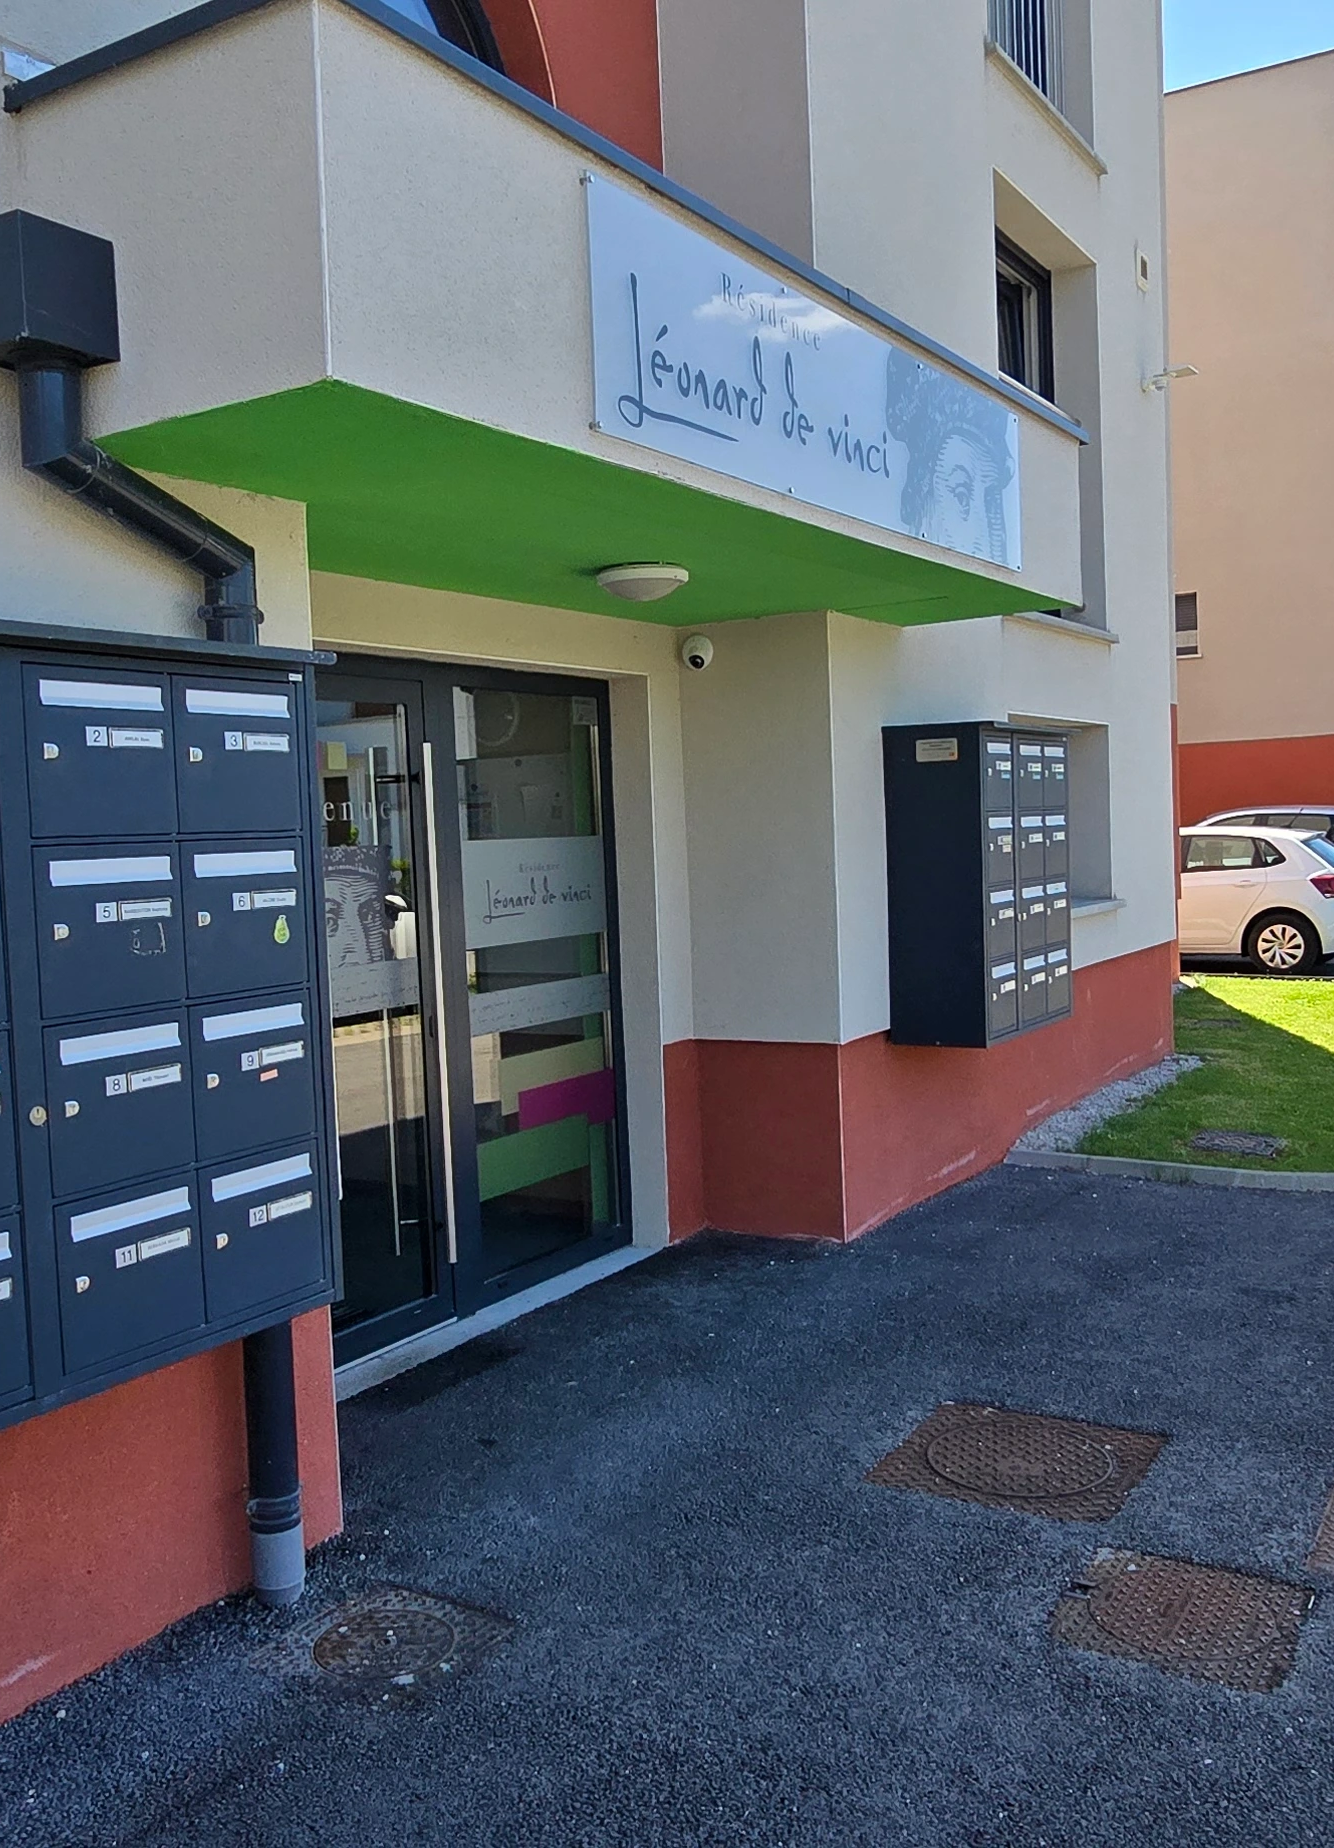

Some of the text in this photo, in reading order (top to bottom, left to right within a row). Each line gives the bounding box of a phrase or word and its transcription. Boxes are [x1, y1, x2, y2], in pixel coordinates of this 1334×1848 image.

[721, 272, 822, 352] Résidence
[618, 272, 891, 479] Léonard de vinci
[92, 730, 102, 743] 2
[229, 734, 238, 747] 3
[237, 895, 246, 908] 6
[482, 875, 592, 925] Léonard de vinci
[102, 905, 112, 919] 5
[246, 1054, 254, 1067] 9
[112, 1078, 121, 1092] 8
[252, 1208, 265, 1223] 12
[120, 1249, 133, 1263] 11
